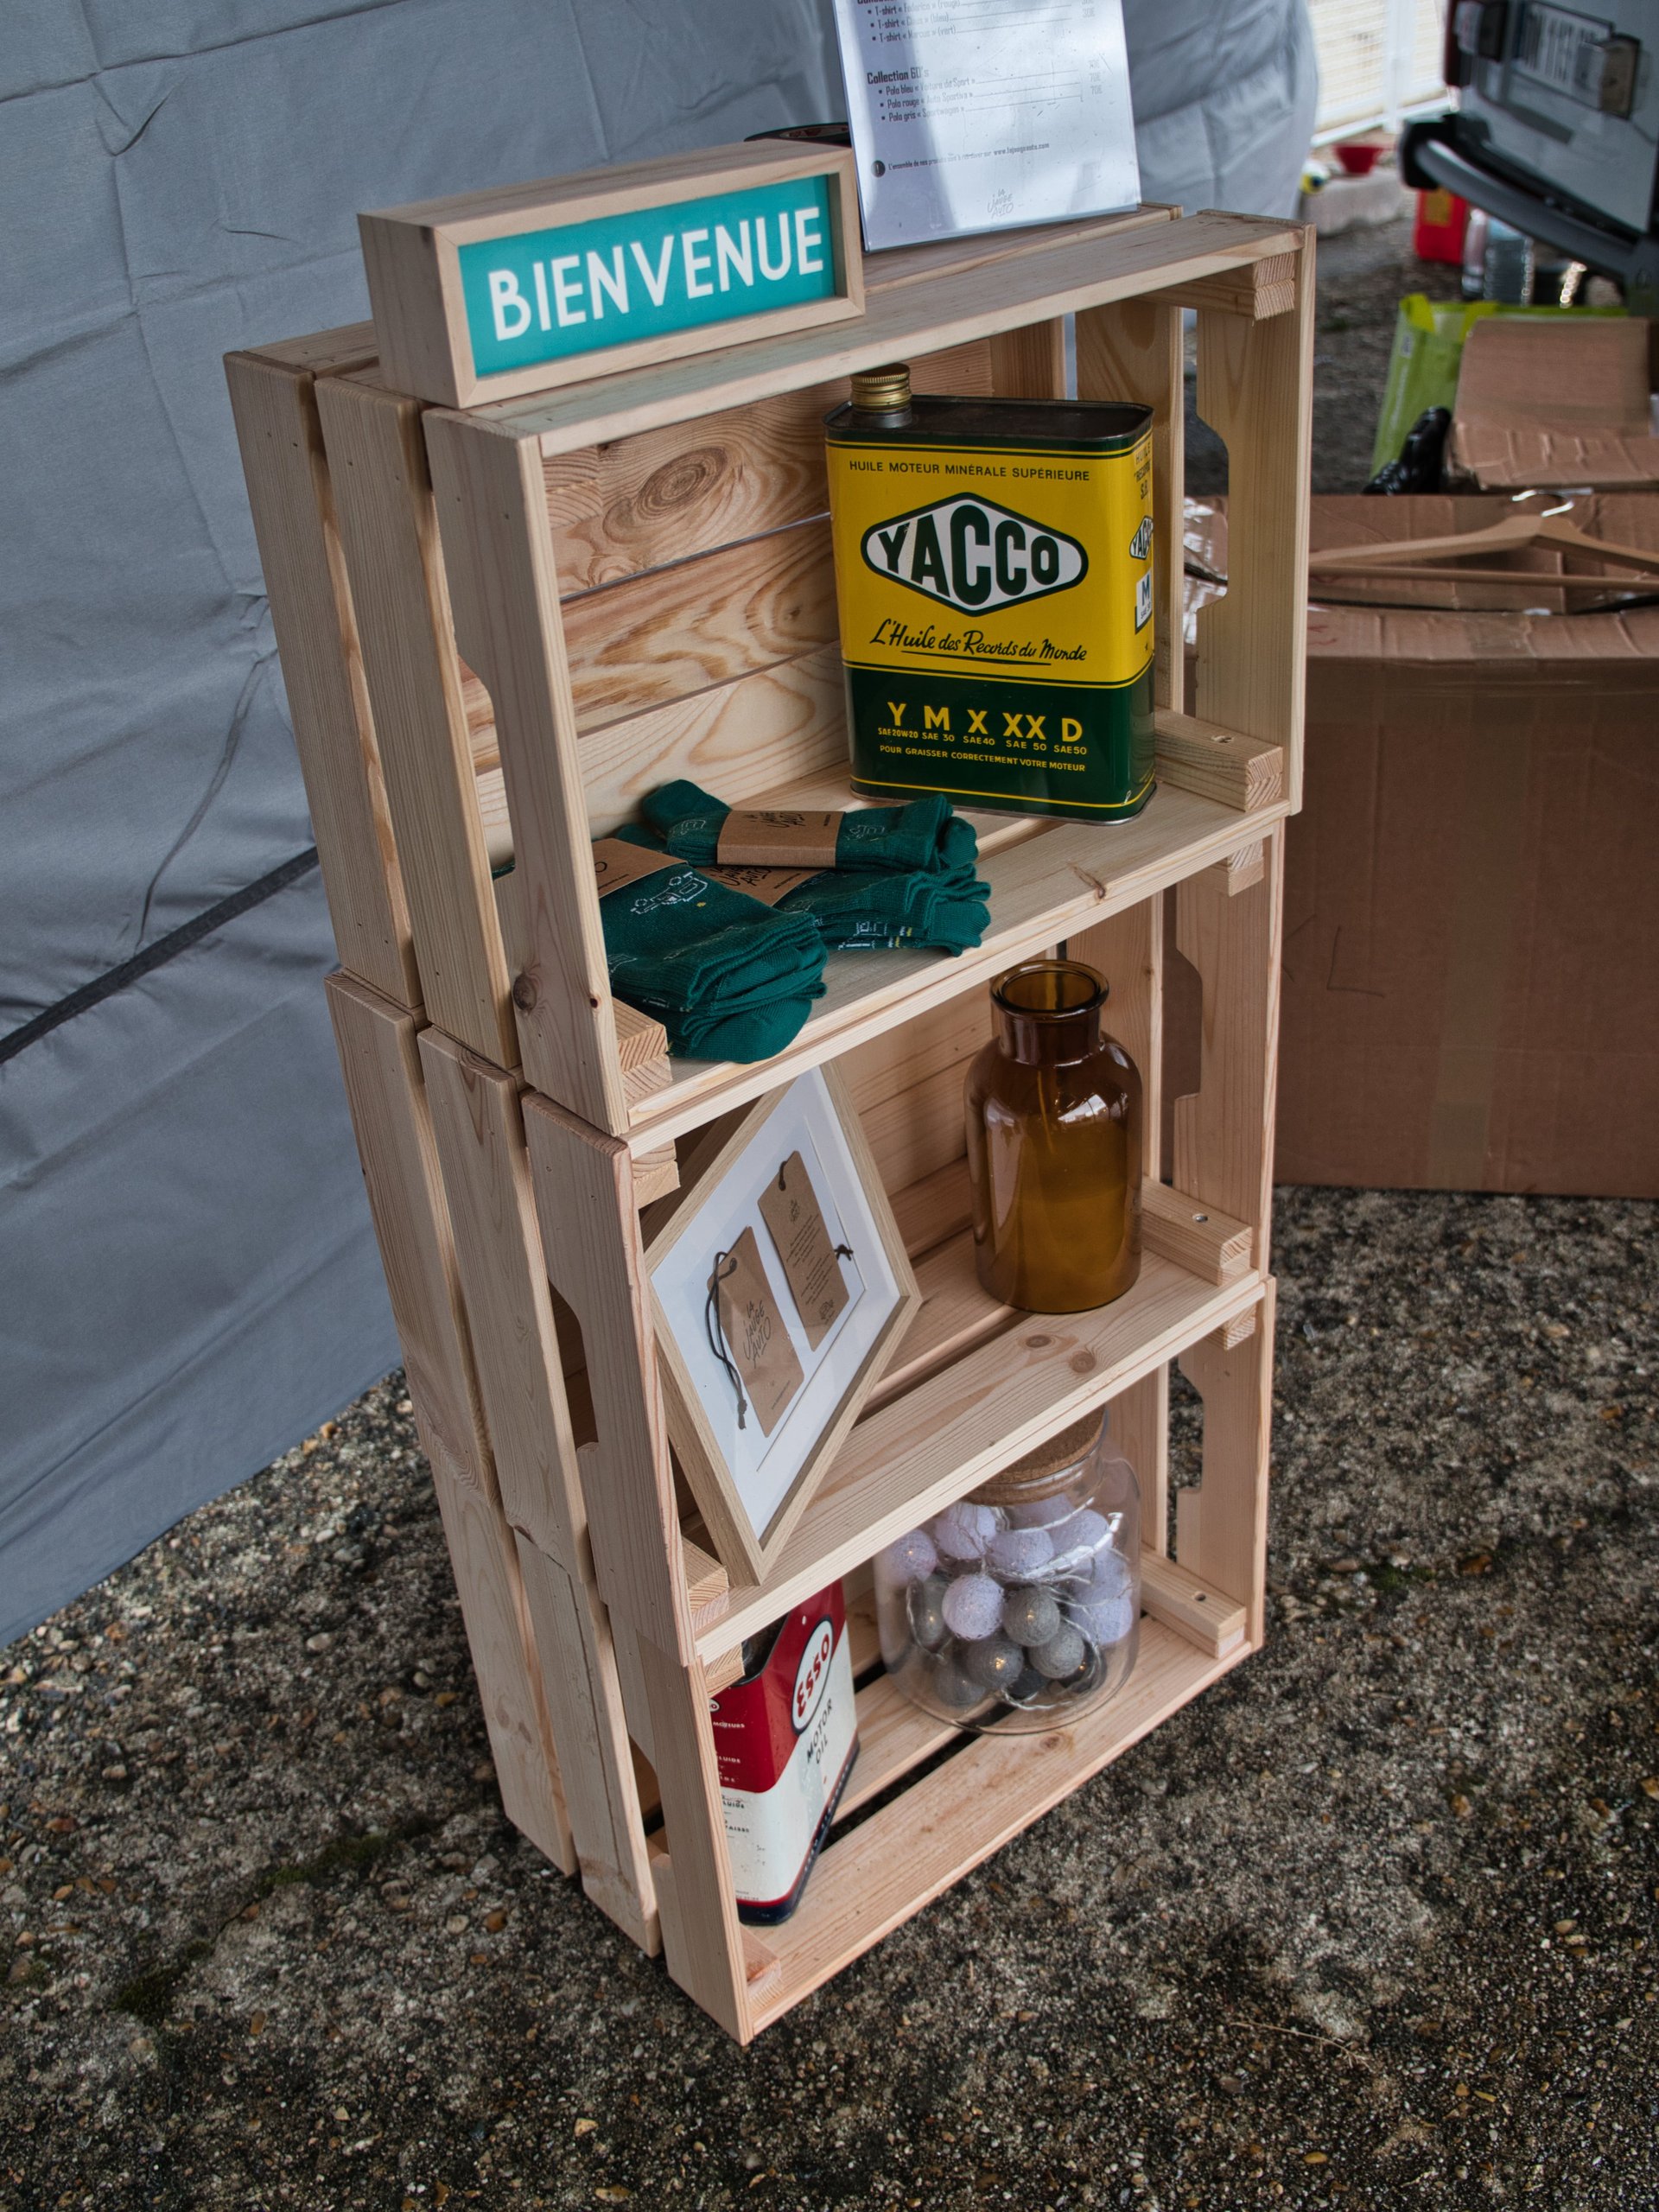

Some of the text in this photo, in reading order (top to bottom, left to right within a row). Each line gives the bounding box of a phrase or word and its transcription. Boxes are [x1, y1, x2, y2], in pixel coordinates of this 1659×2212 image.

[875, 5, 897, 16] T-shirt
[878, 18, 899, 29] T-shirt
[880, 31, 901, 42] T-shirt
[938, 24, 957, 36] (vert)
[867, 71, 909, 85] Collection
[886, 86, 899, 96] Polo
[900, 85, 913, 94] bleu
[887, 99, 901, 109] Polo
[902, 98, 919, 108] rouge
[888, 111, 903, 122] Polo
[904, 111, 916, 122] gris
[489, 207, 823, 341] BIENVENUE
[849, 461, 1090, 481] HUILE MOTEUR MINÉRALE SUPÉRIEURE
[877, 505, 1059, 605] YACCO
[869, 618, 1087, 661] L'Huile des Records du Monde
[887, 702, 1083, 742] Y M X XX D
[922, 732, 938, 741] SAE
[943, 734, 955, 742] 30
[1006, 740, 1027, 749] SAE
[1033, 742, 1047, 752] 50
[880, 745, 1085, 772] POUR GRAISSER CORRECTEMENT VOTRE MOTEUR
[747, 1300, 754, 1319] LA
[753, 1316, 772, 1370] AUTO
[796, 1633, 830, 1719] ESSO
[807, 1698, 833, 1764] MOTOR
[816, 1733, 828, 1764] OIL
